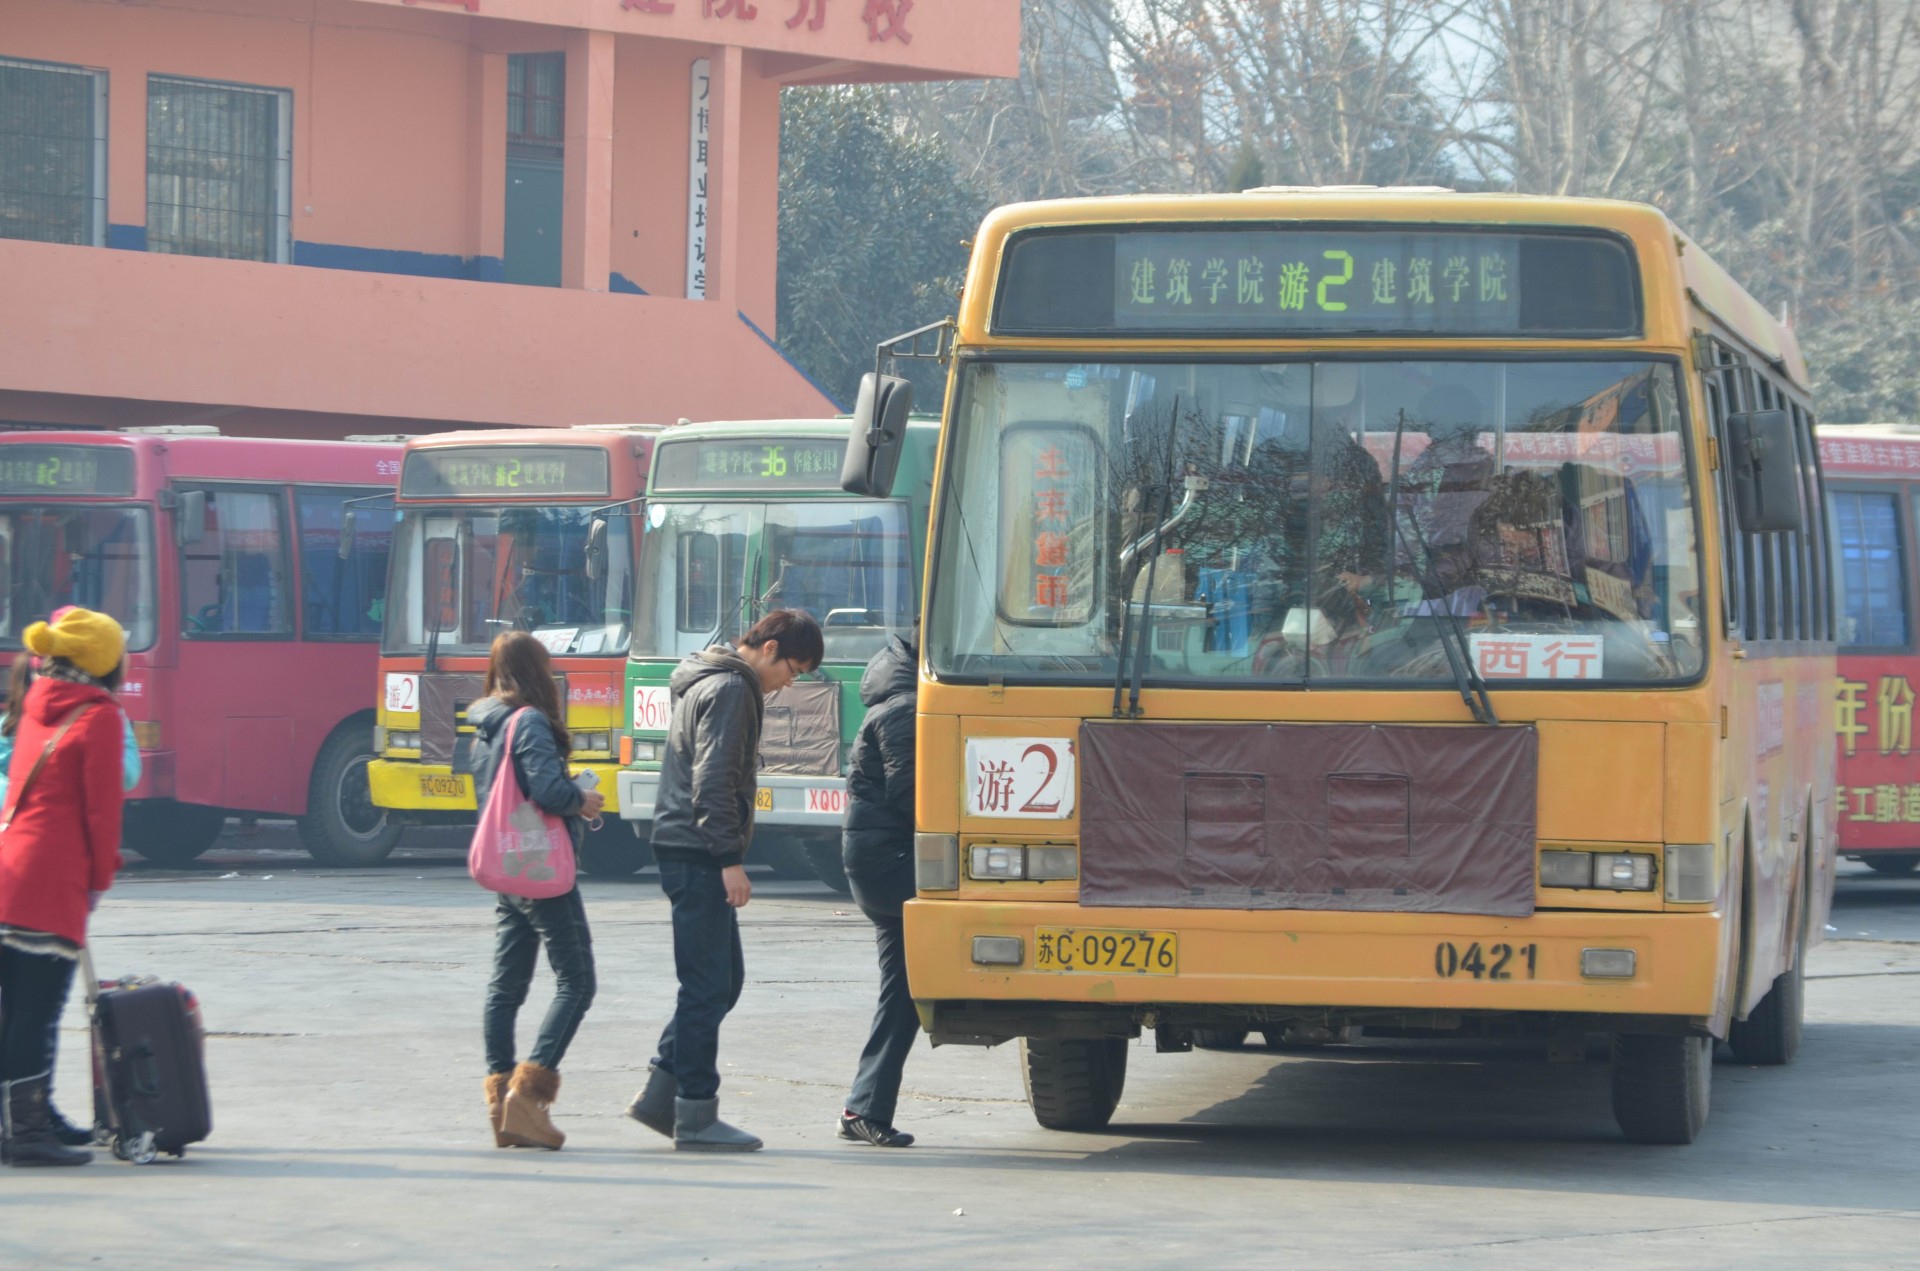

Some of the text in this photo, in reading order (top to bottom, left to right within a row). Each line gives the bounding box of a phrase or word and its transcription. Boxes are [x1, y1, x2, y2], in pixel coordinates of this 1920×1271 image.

[1131, 249, 1508, 312] 建筑学院 游2 建筑学院
[760, 445, 787, 477] 36
[1477, 641, 1598, 679] 西行
[1835, 677, 1915, 756] 年份
[977, 743, 1061, 813] 游2
[1435, 942, 1537, 979] 0421
